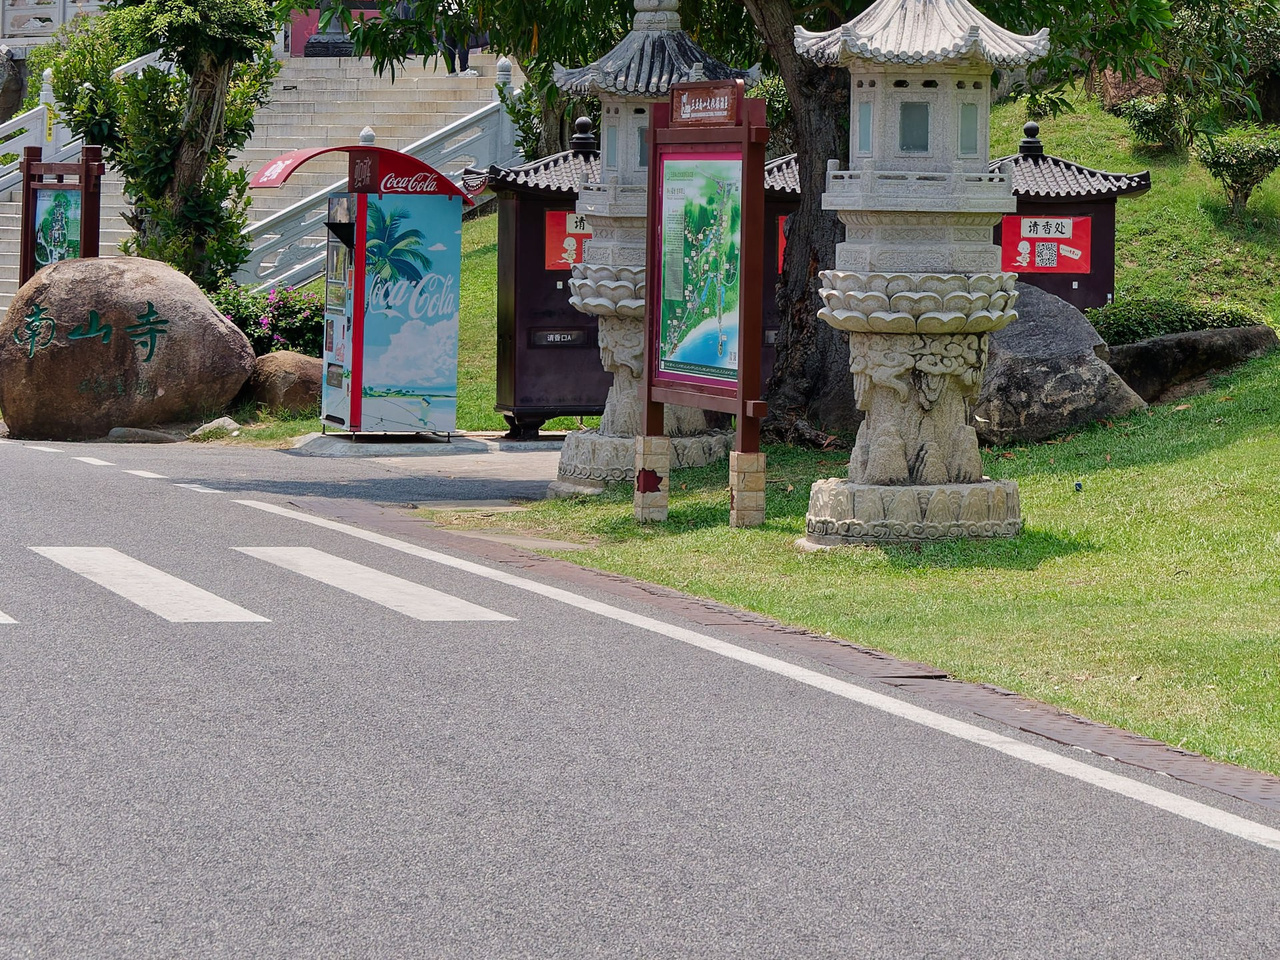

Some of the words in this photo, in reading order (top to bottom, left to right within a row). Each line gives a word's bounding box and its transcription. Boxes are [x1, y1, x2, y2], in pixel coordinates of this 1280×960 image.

[380, 172, 438, 192] Coca-Cola
[1028, 220, 1066, 235] 请香处
[369, 272, 456, 320] Coca-Cola
[13, 300, 170, 363] 南山寺
